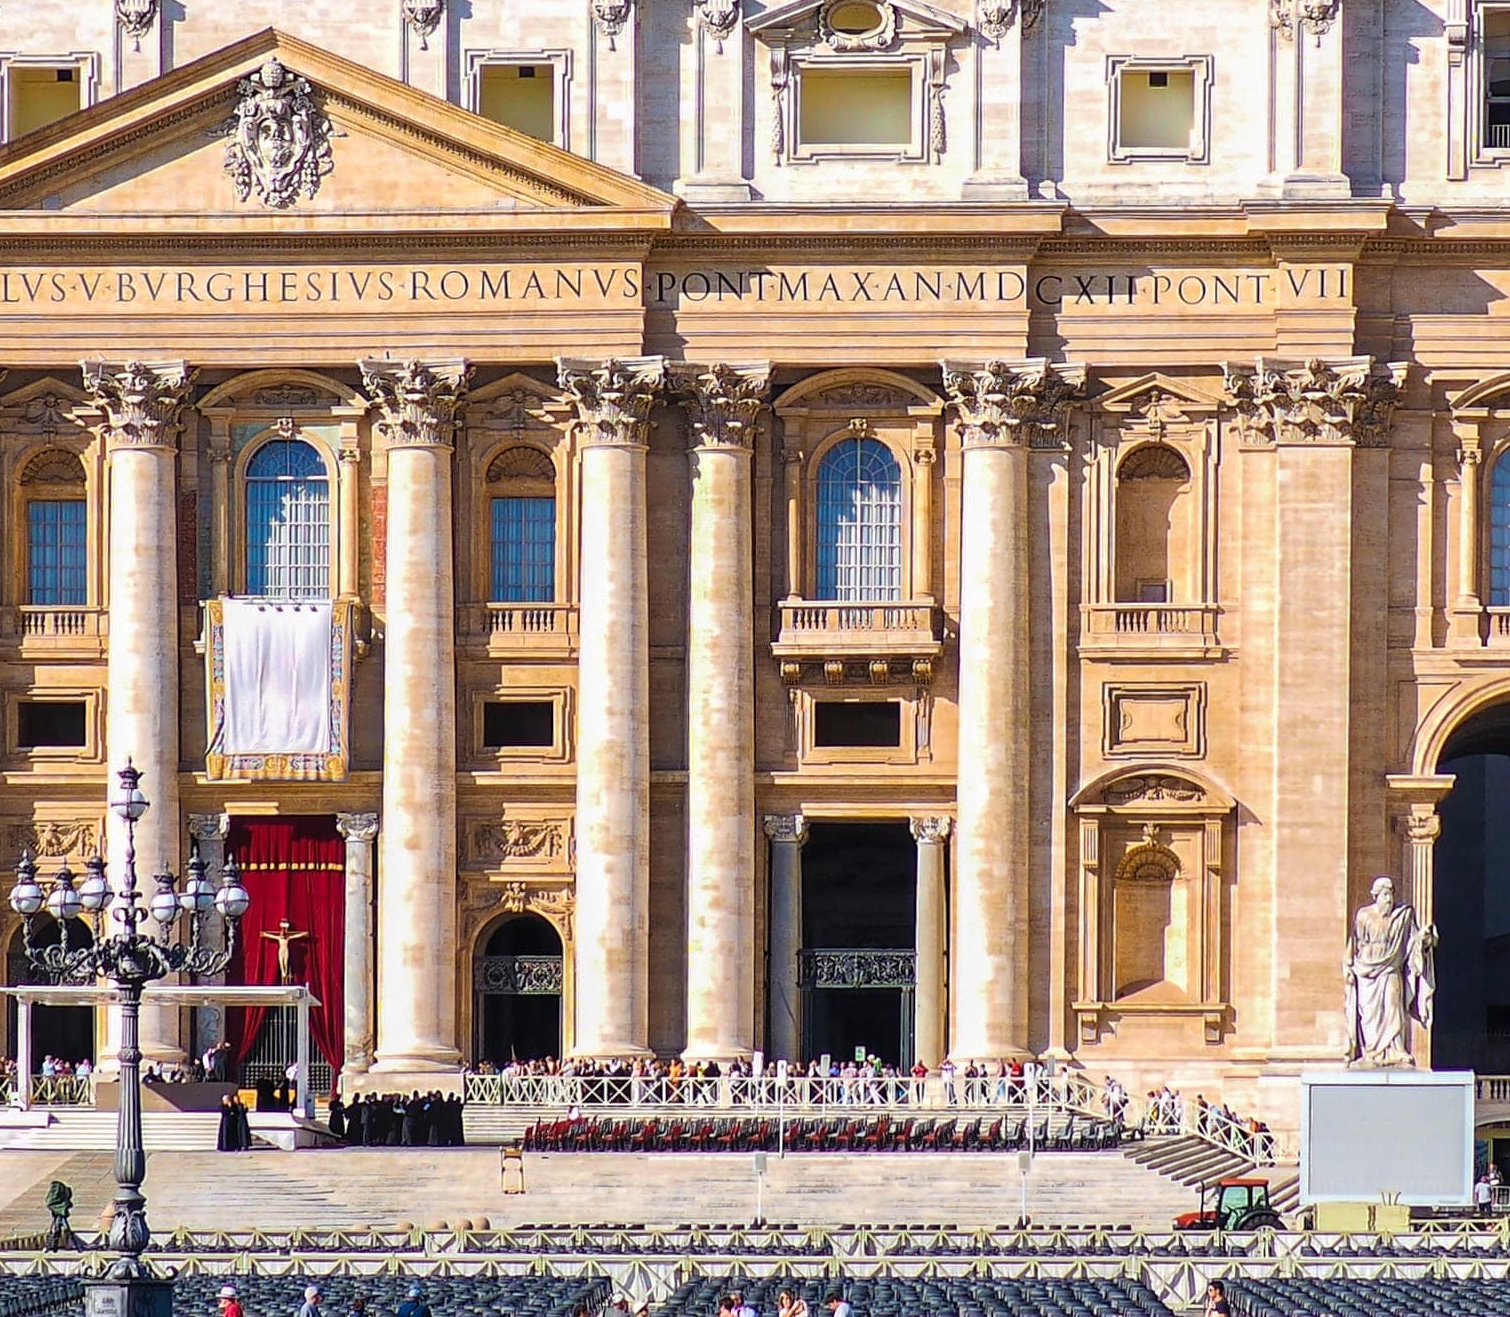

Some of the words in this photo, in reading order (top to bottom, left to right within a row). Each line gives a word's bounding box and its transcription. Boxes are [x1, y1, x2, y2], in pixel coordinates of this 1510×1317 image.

[116, 270, 394, 302] BVRGHESIVS
[411, 268, 640, 301] ROMANVS
[656, 271, 770, 302] PONT
[778, 272, 877, 302] MAX
[883, 272, 942, 302] AN
[1150, 274, 1271, 304] PONT
[1286, 268, 1349, 299] VII
